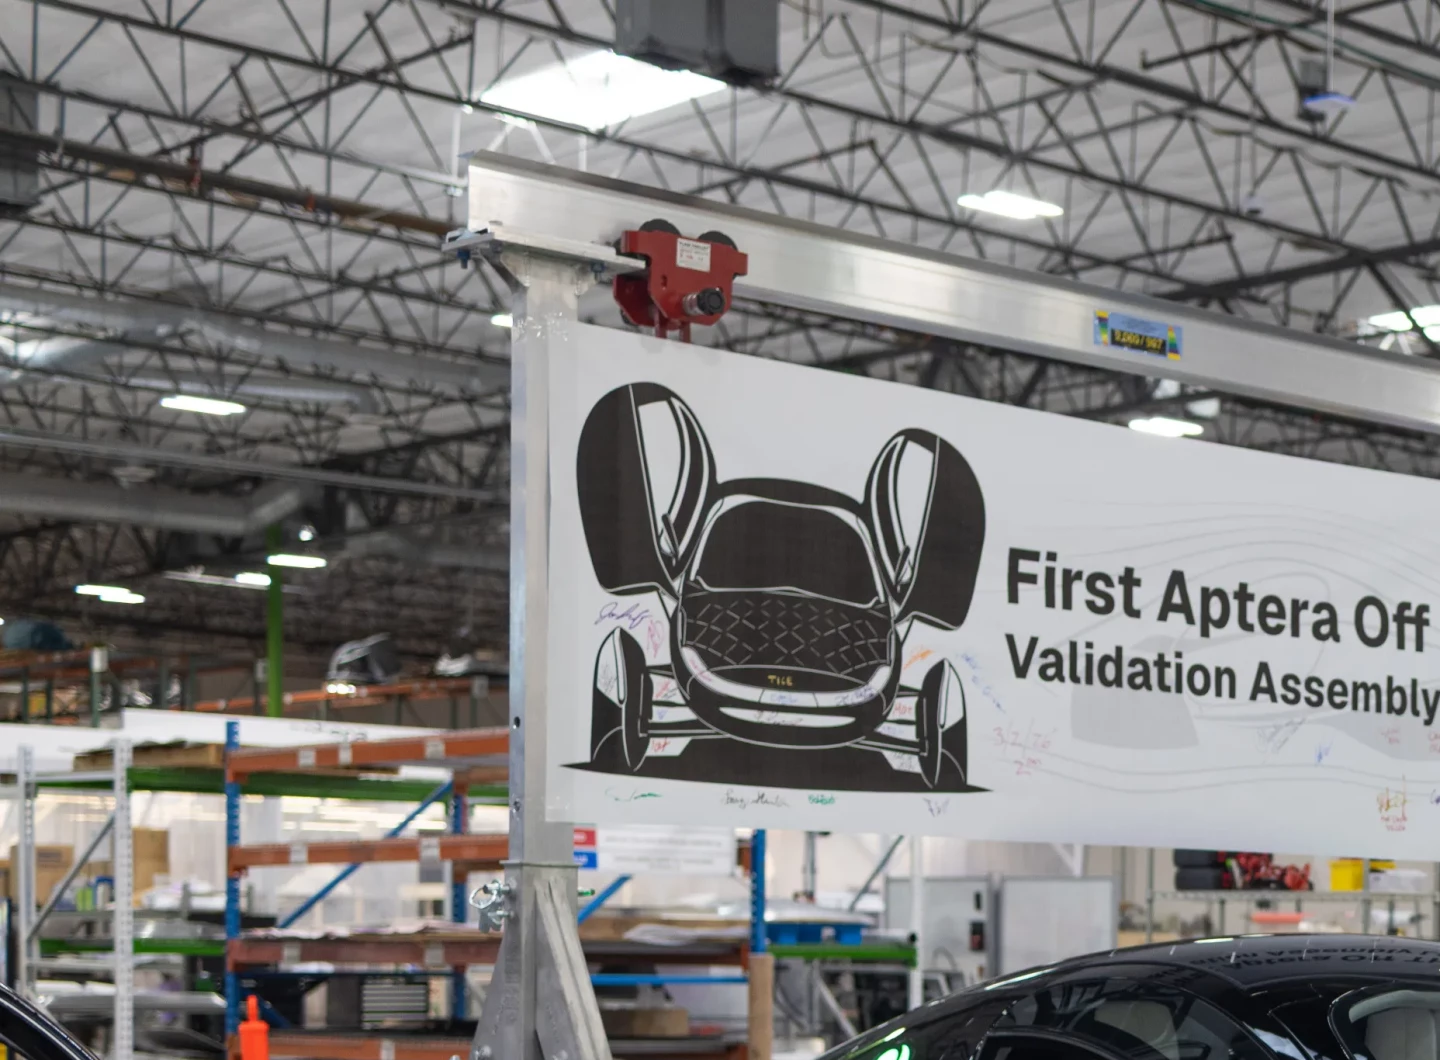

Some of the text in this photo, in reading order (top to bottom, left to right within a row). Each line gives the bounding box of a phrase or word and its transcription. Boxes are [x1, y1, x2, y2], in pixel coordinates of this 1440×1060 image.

[1007, 546, 1142, 619] First
[1156, 569, 1341, 643] Aptera
[1354, 595, 1430, 652] Off
[1005, 633, 1237, 699] Validation
